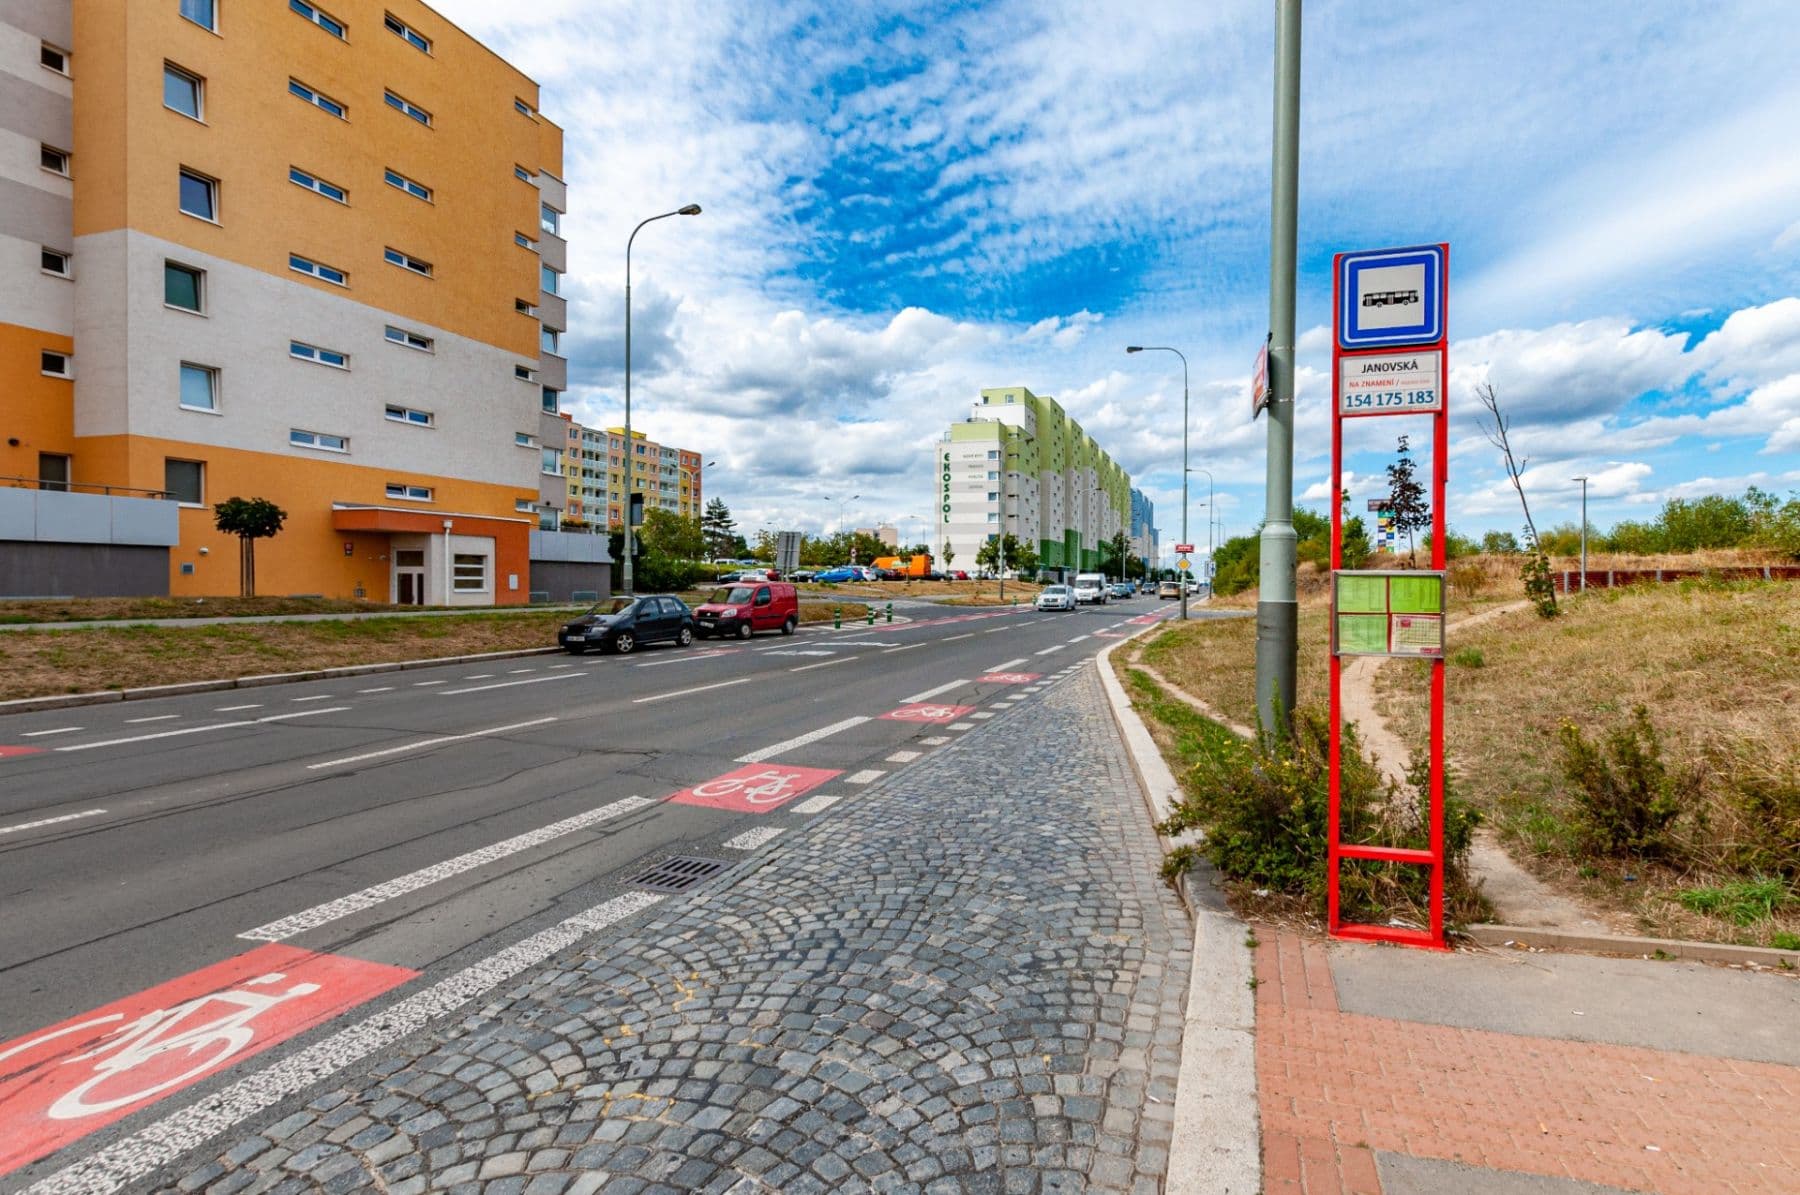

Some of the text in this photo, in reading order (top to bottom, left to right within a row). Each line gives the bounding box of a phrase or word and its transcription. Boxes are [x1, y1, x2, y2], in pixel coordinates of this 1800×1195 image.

[1361, 359, 1418, 373] JANOVSKÁ
[1361, 378, 1394, 388] ZNAMENÍ
[1346, 390, 1434, 407] 154 175 183
[943, 452, 951, 523] EKOSPOL
